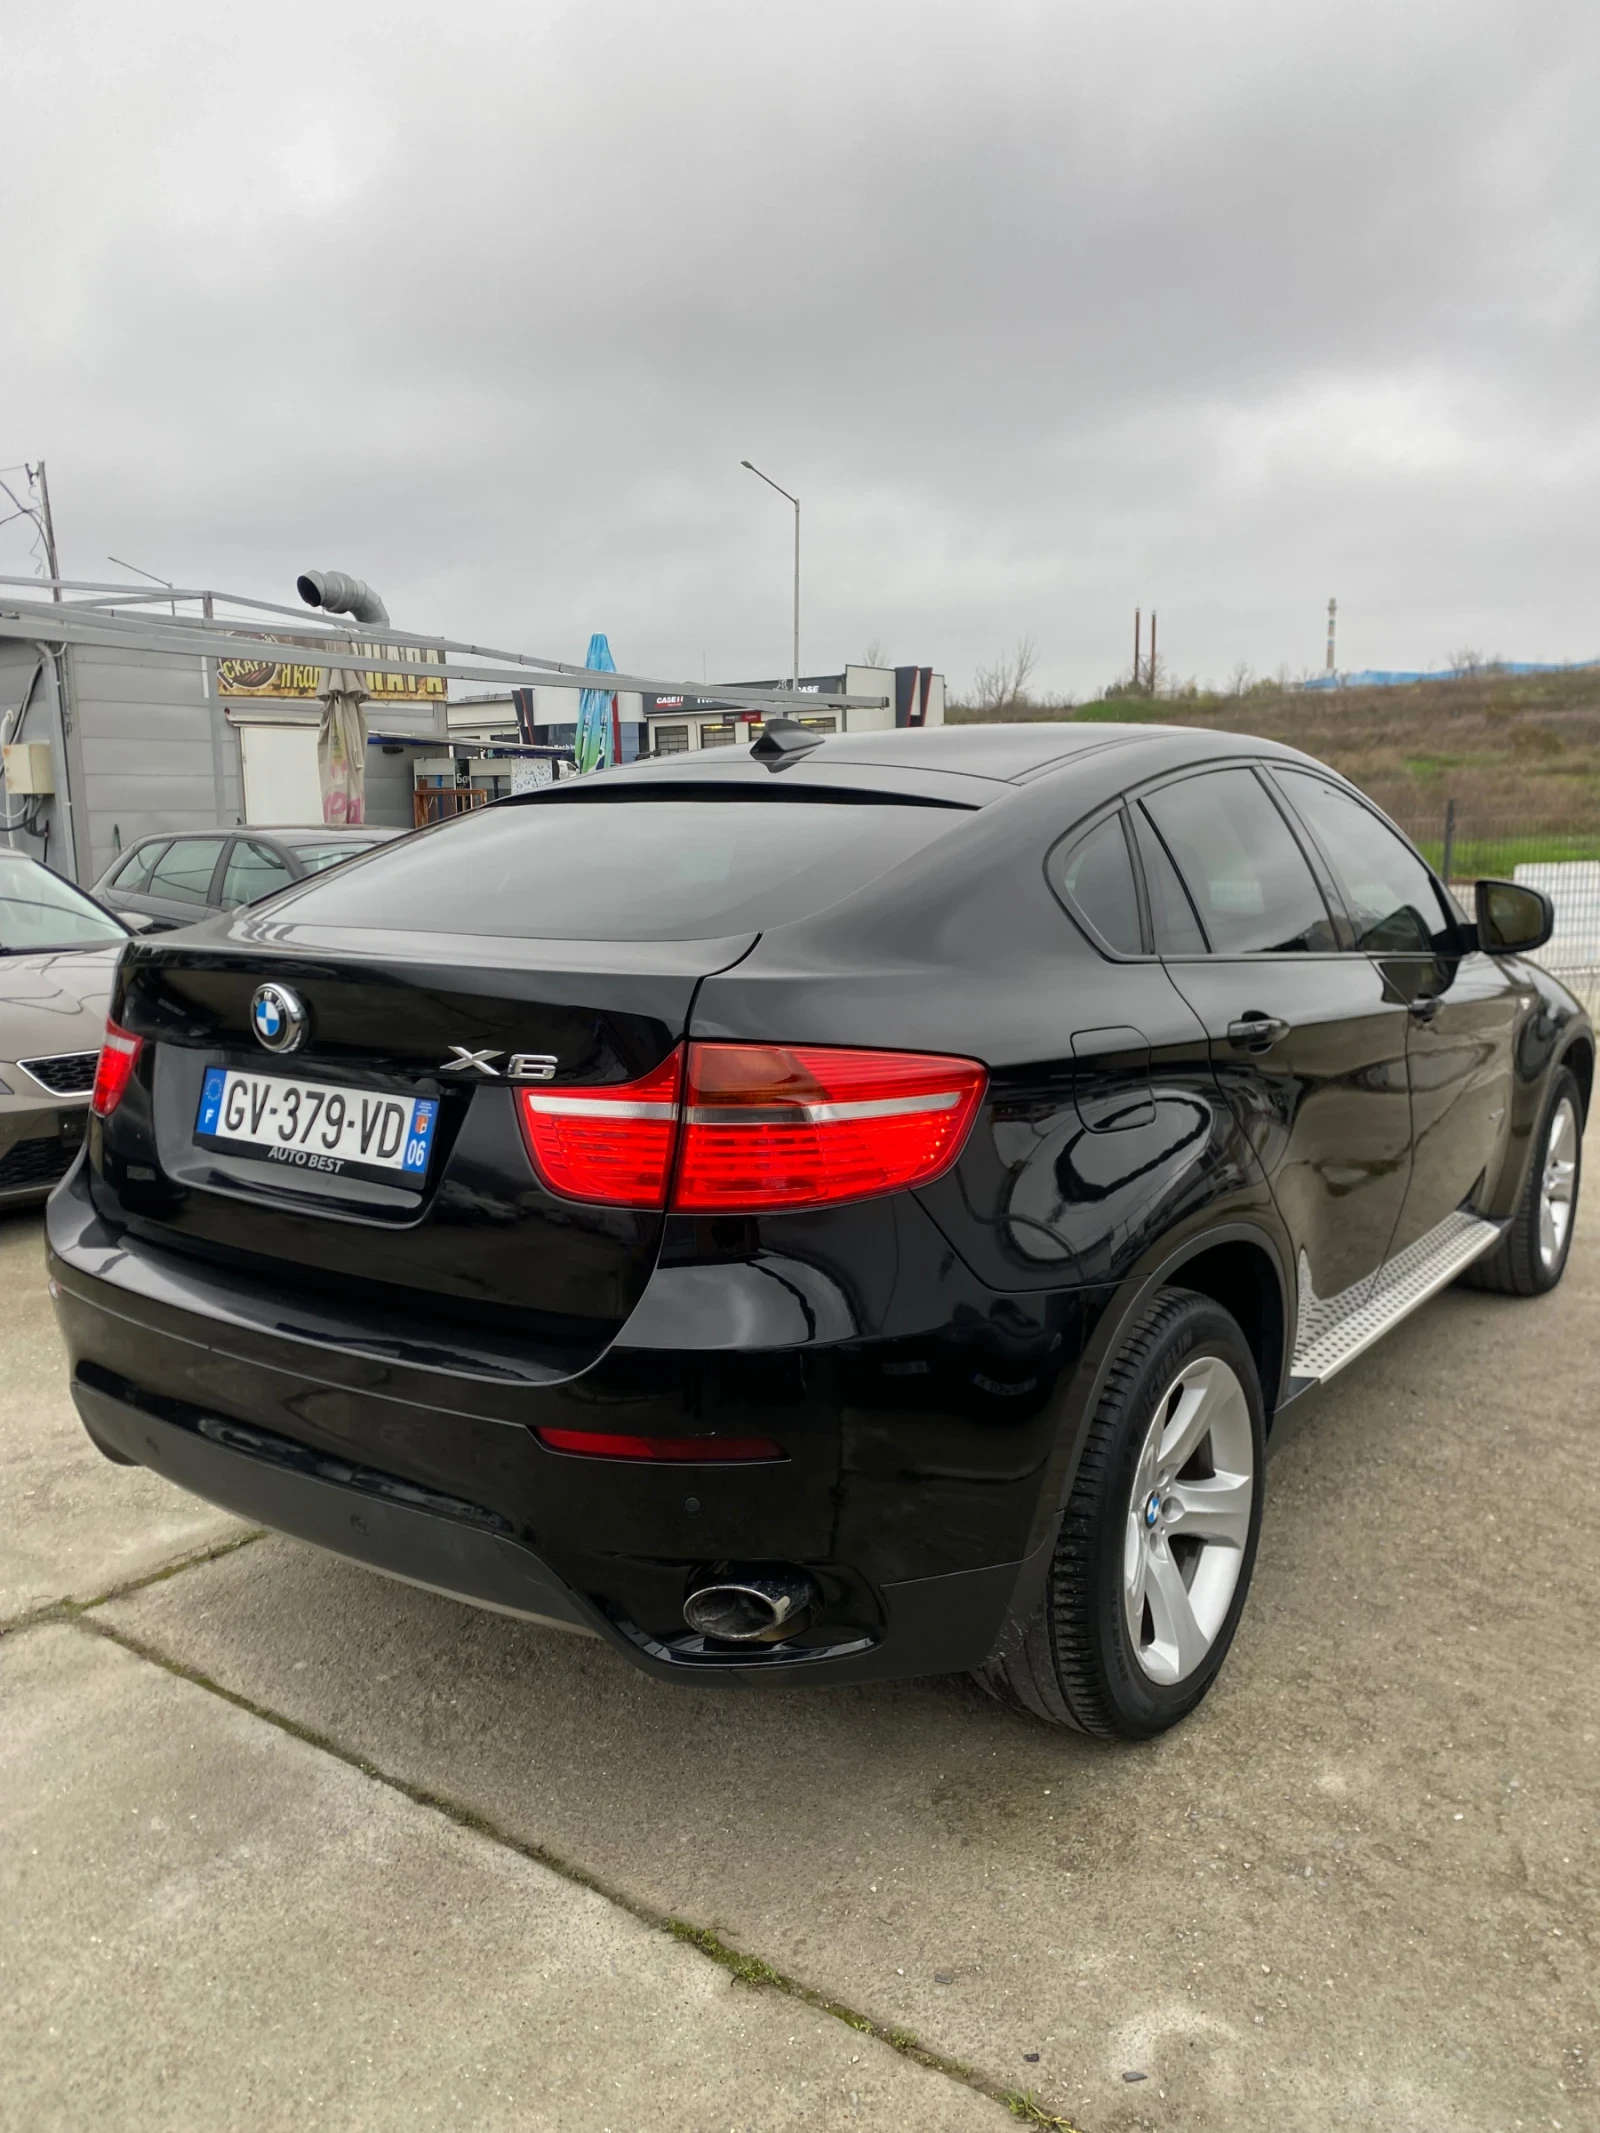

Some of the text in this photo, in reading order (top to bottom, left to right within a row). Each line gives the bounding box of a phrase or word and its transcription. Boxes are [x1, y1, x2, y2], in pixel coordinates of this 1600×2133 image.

[440, 1045, 558, 1080] X6
[205, 1109, 214, 1124] F
[224, 1079, 405, 1159] GV-379-VD
[407, 1139, 426, 1167] 06
[268, 1147, 345, 1174] AUTO BEST
